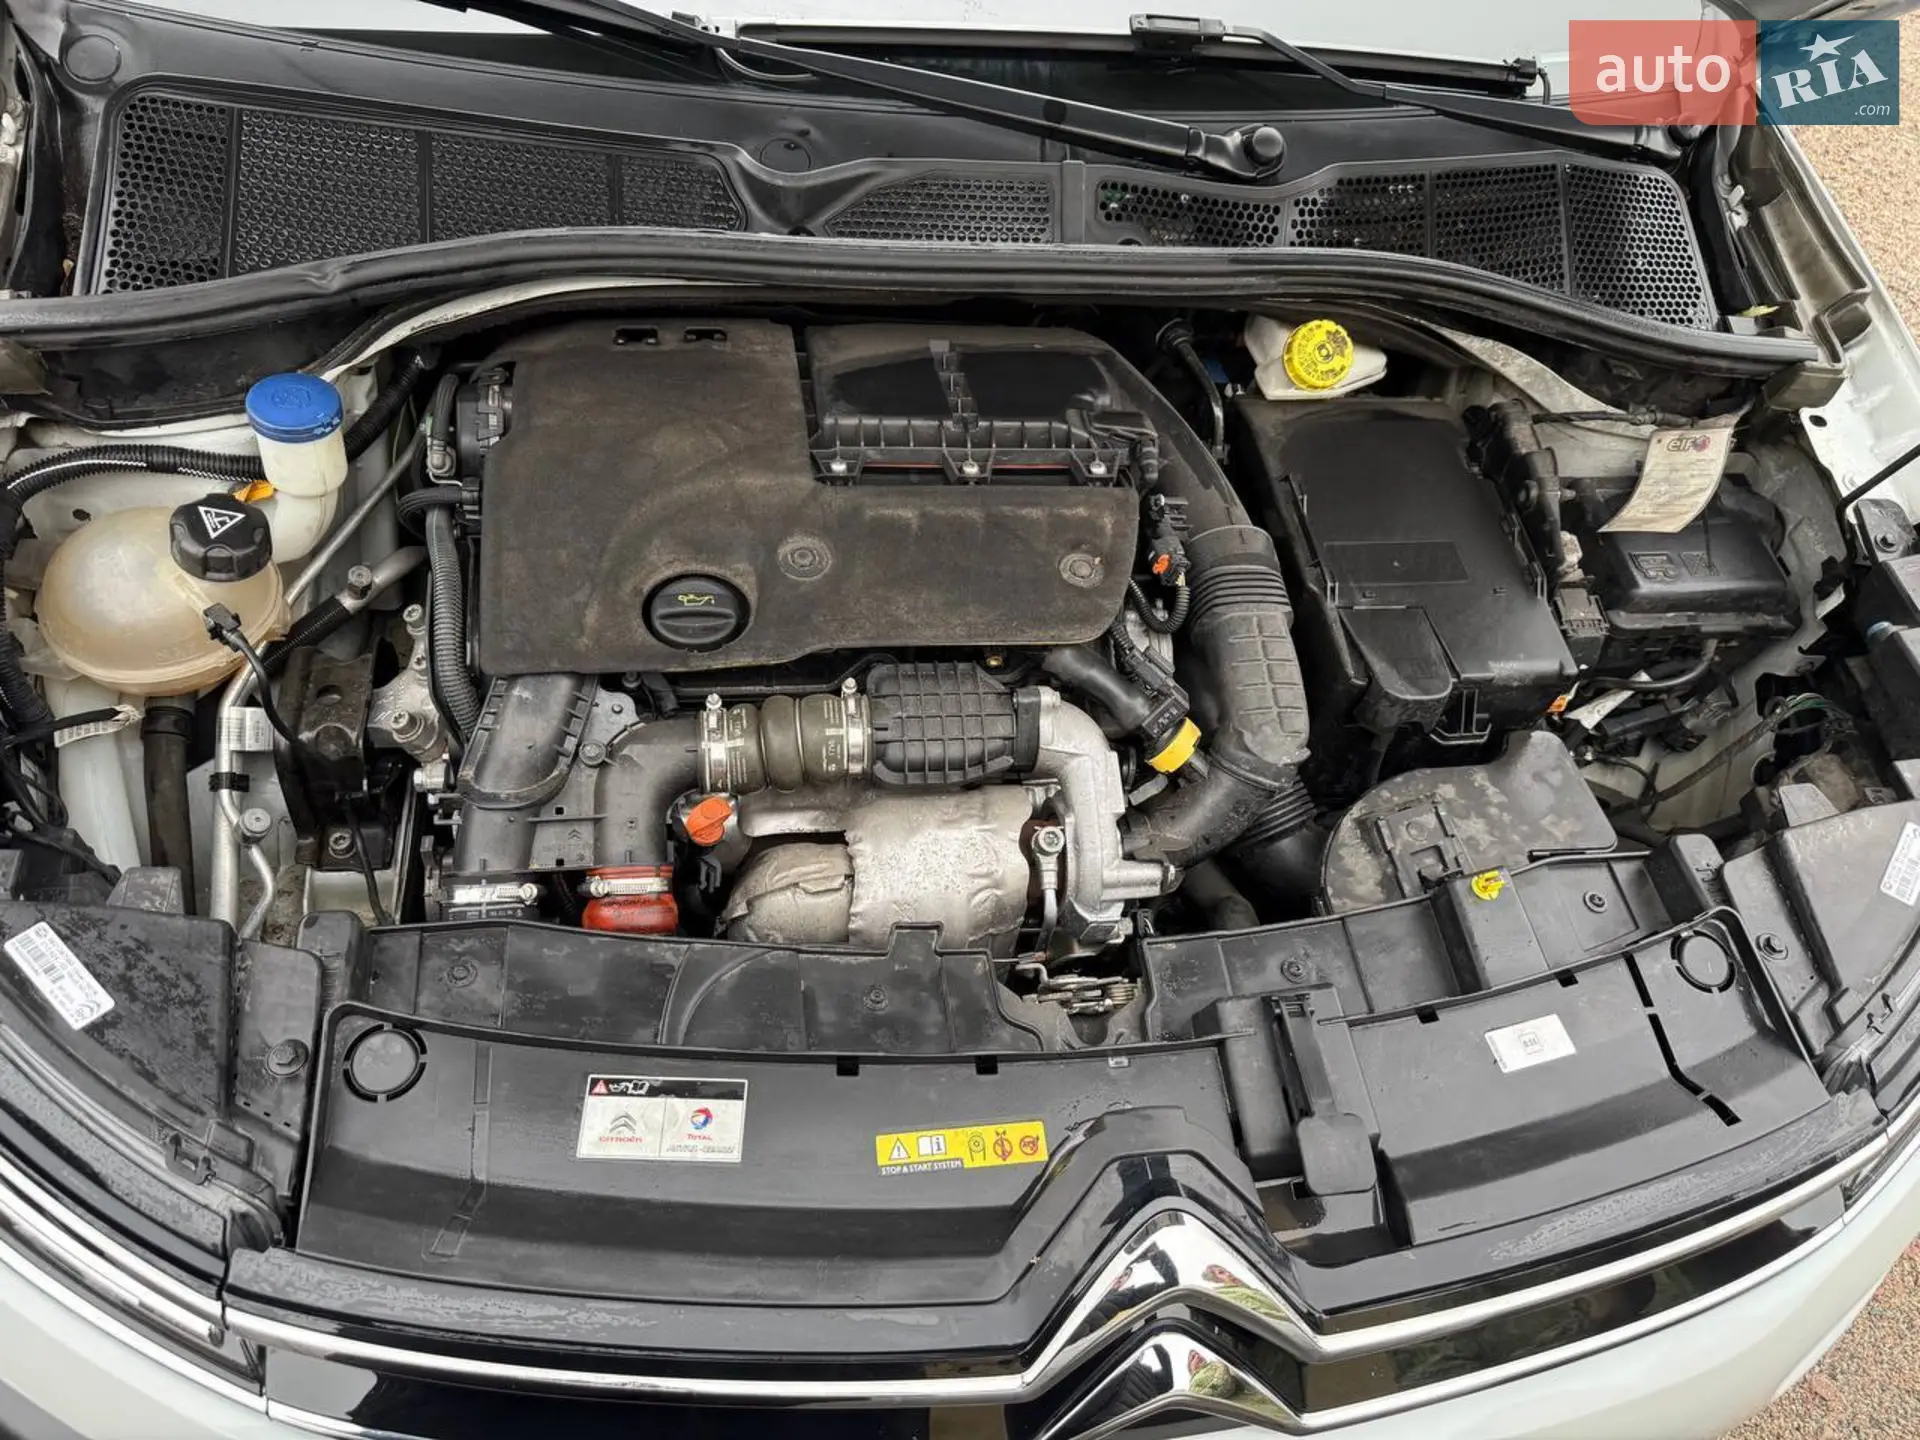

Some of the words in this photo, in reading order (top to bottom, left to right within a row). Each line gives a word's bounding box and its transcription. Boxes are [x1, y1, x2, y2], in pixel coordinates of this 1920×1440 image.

[686, 1133, 713, 1141] TOTAL
[881, 1165, 900, 1175] STOP
[910, 1163, 931, 1173] START
[933, 1160, 962, 1170] SYSTEM
